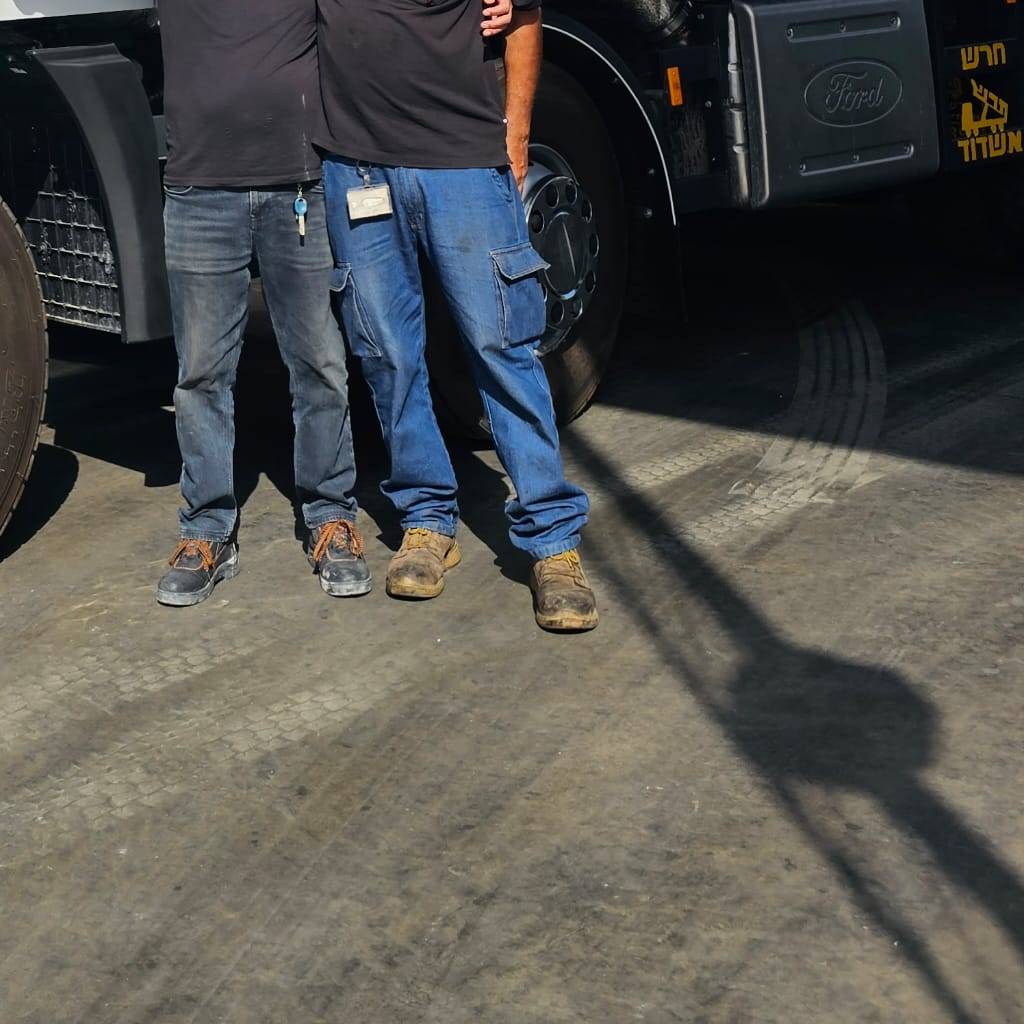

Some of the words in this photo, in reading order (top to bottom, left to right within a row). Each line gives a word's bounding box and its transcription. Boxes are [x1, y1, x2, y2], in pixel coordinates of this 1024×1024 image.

[961, 42, 1006, 70] חרש
[825, 71, 884, 114] Ford
[957, 130, 1023, 162] אשדוד
